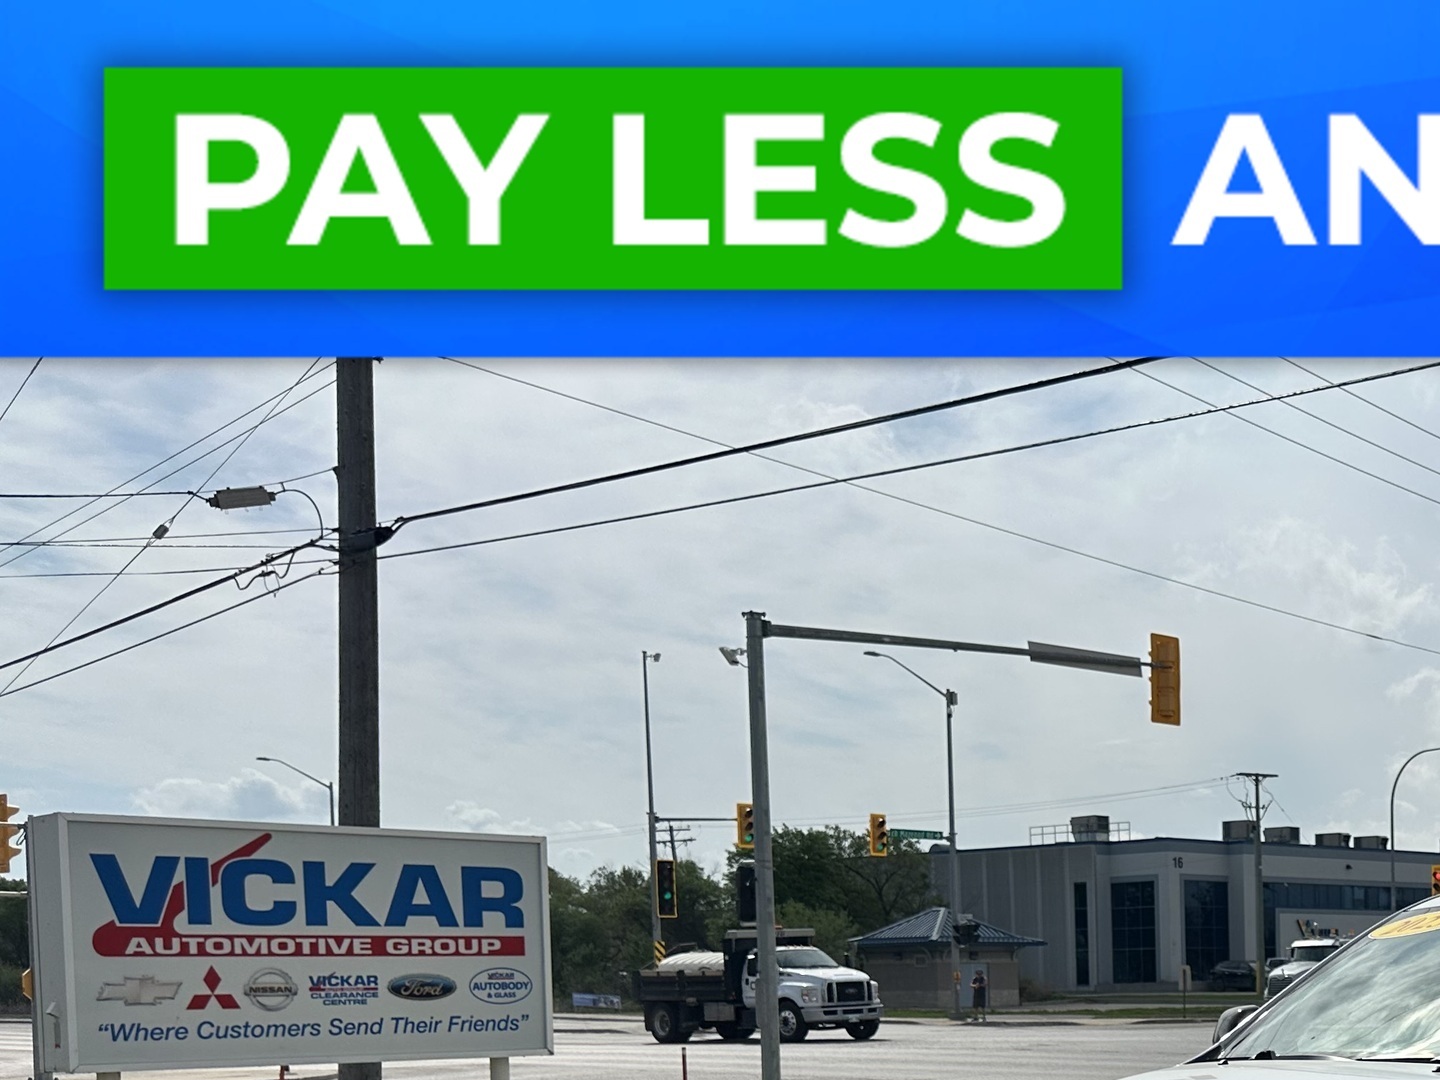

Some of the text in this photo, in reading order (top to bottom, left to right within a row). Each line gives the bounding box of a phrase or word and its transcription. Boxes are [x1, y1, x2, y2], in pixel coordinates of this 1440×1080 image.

[1172, 856, 1184, 869] 16
[89, 853, 524, 928] VICKAR
[125, 937, 502, 955] AUTOMOTIVE GROUP
[309, 975, 379, 986] VICKAR
[401, 979, 442, 996] Ford
[472, 981, 529, 991] AUTOBODY
[250, 986, 293, 994] NISSAN
[196, 1020, 321, 1039] Customers
[328, 1017, 384, 1036] Send
[391, 1015, 442, 1034] Their
